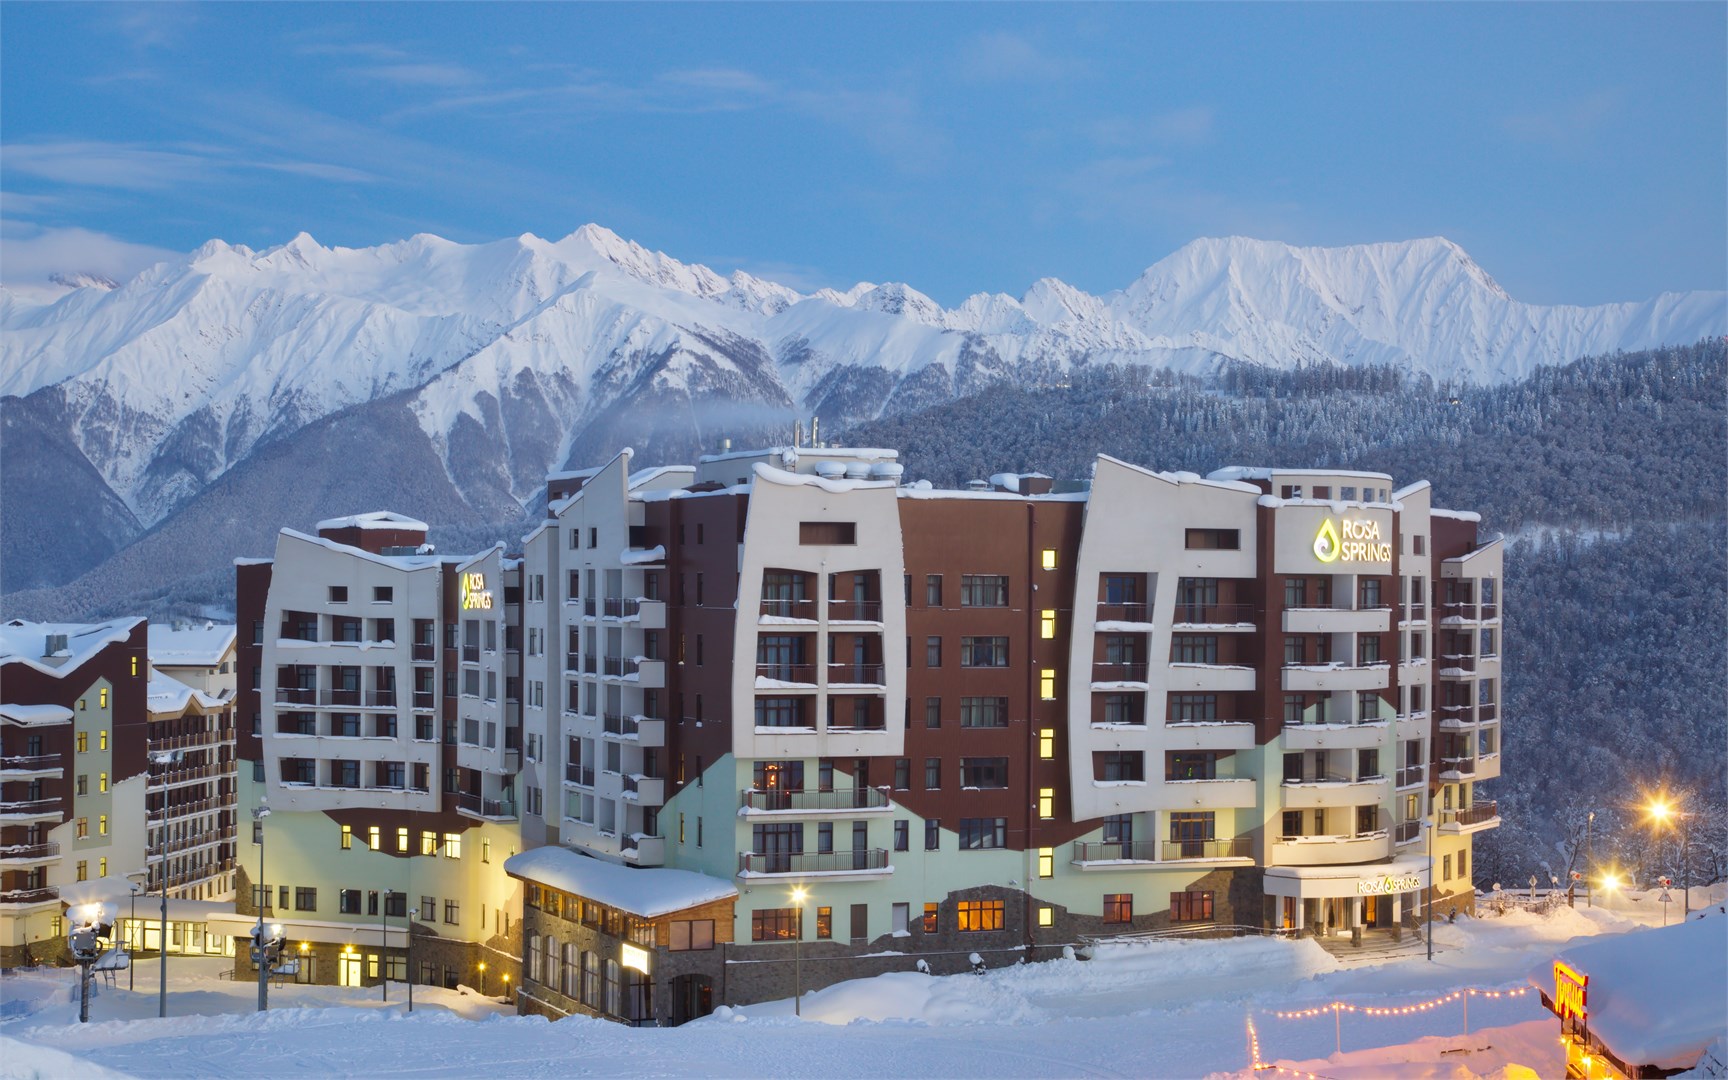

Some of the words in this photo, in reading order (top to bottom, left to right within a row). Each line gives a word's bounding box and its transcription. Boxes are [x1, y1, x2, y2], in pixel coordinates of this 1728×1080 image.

[1342, 519, 1380, 540] ROSA
[1341, 541, 1392, 562] SPRINGS
[469, 573, 484, 590] ROSA
[469, 592, 492, 609] SPRINGS
[1358, 880, 1384, 894] ROSA
[1393, 876, 1420, 891] SPRINGS
